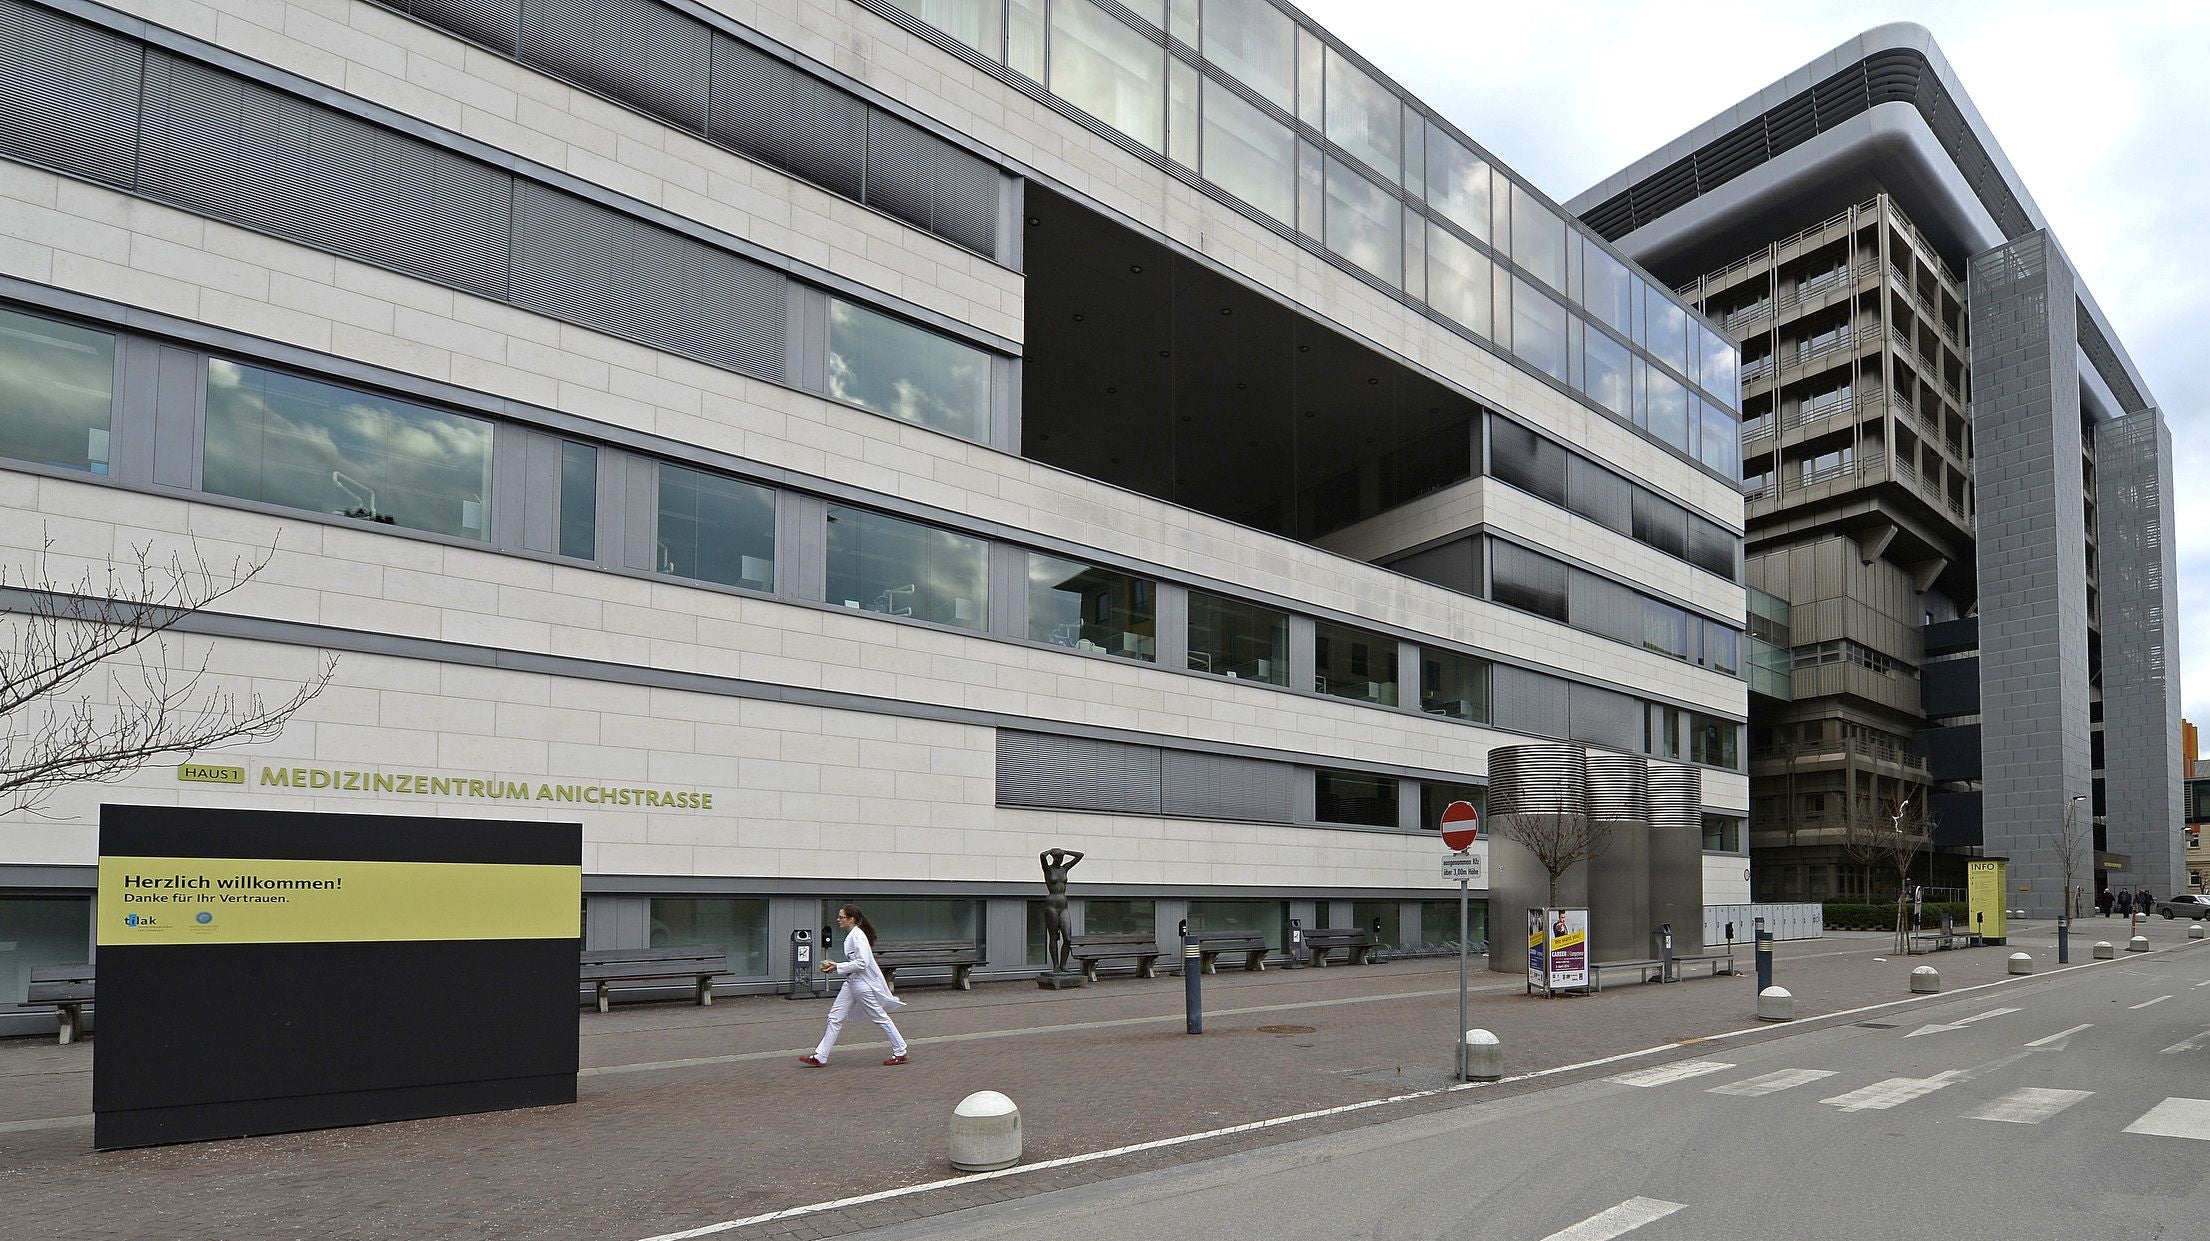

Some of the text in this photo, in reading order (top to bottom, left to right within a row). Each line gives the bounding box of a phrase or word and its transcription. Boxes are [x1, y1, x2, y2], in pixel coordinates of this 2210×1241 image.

[185, 768, 238, 780] HAUS 1
[260, 766, 713, 810] MEDIZINZENTRUM ANICHSTRASSE
[1443, 868, 1452, 876] über
[1468, 867, 1479, 875] Höhe
[124, 875, 342, 890] Herzlich willkommen!
[124, 893, 290, 903] Danke für Ihr Vertrauen.
[124, 914, 157, 926] tilak
[1562, 935, 1572, 943] want
